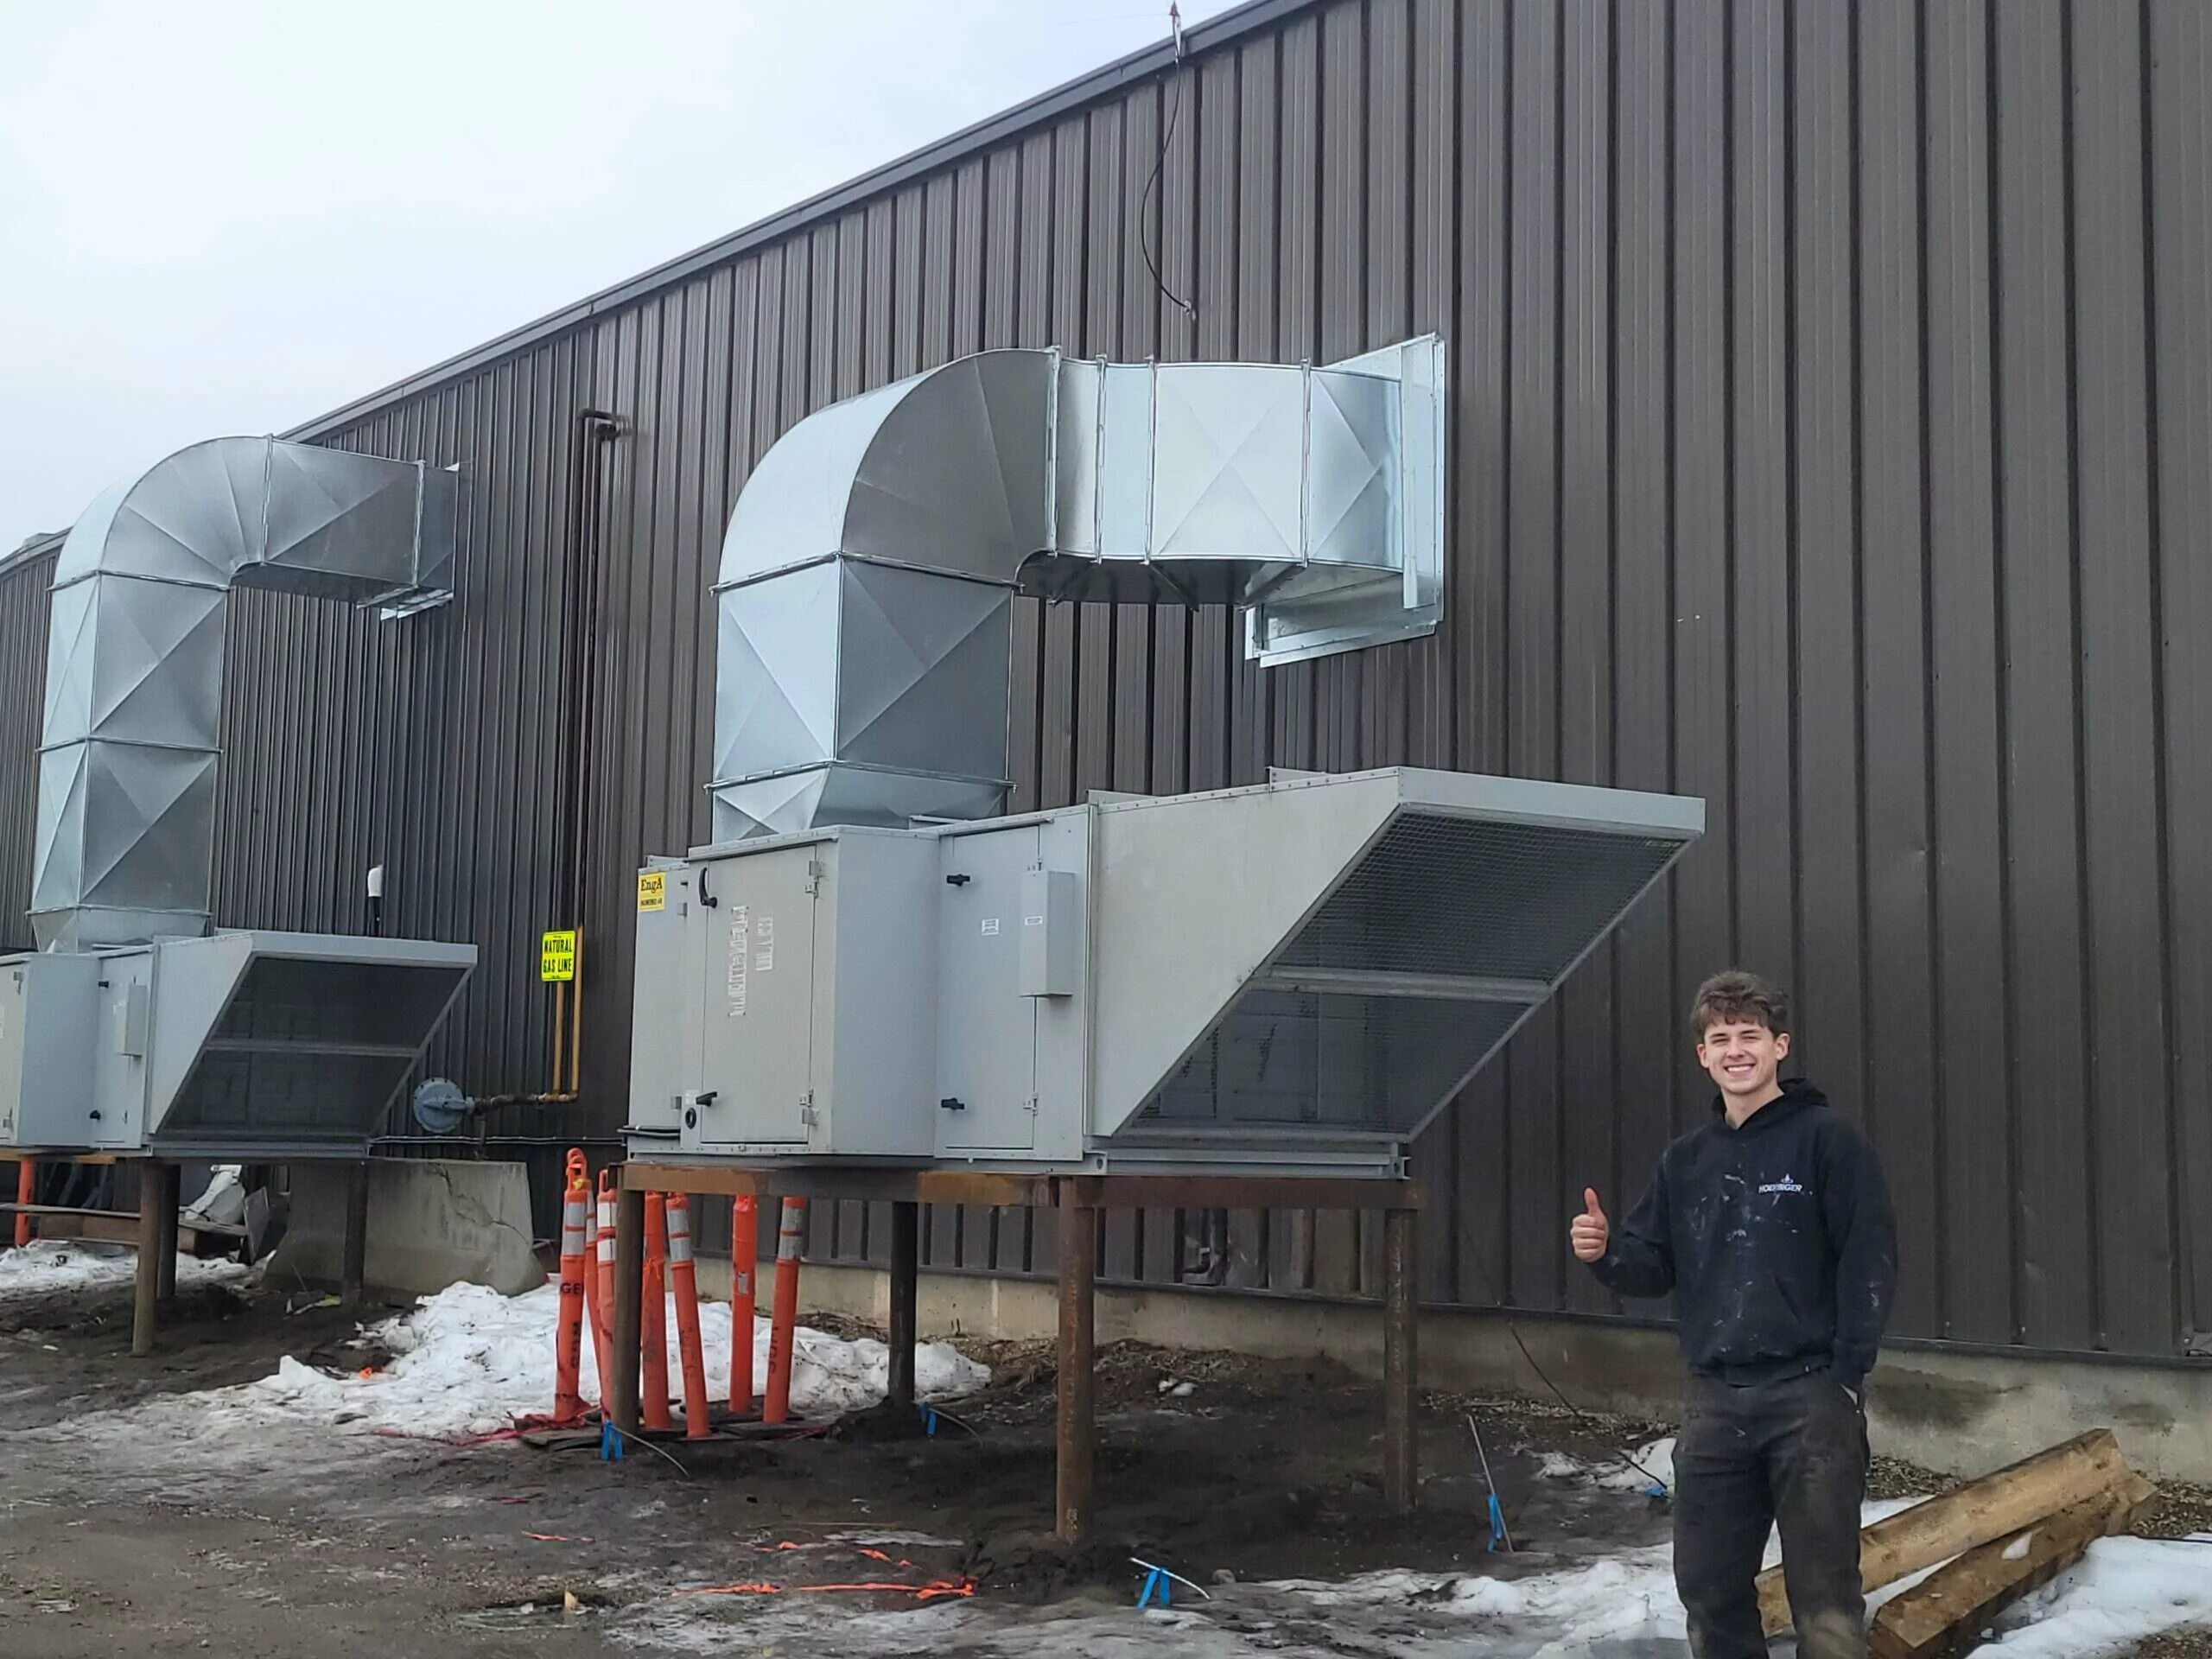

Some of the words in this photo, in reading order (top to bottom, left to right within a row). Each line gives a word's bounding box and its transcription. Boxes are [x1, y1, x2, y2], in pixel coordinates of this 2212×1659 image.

[640, 877, 663, 893] EngA
[543, 938, 572, 954] NATURAL
[543, 957, 556, 973] GAS
[557, 957, 572, 972] LINE
